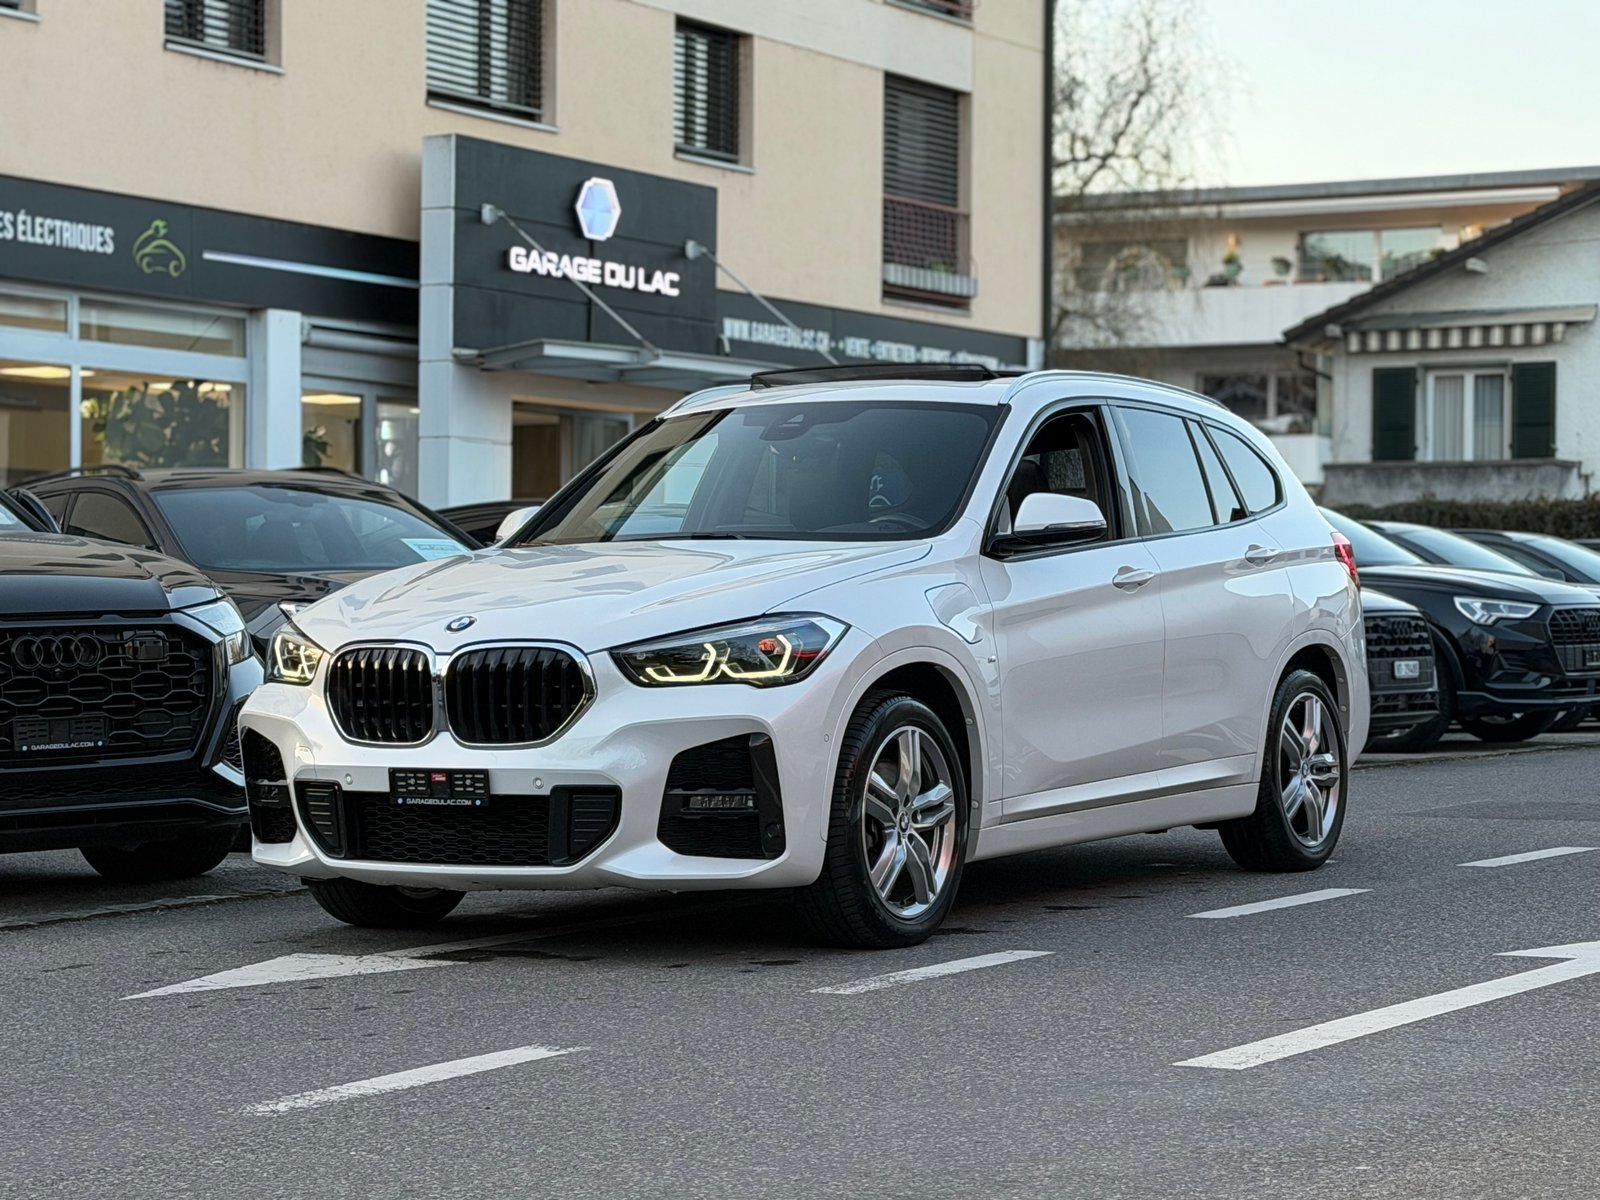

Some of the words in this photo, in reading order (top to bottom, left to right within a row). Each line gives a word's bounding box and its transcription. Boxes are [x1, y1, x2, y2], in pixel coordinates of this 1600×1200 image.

[16, 209, 115, 254] ÉLECTRIQUES
[509, 246, 602, 284] GARAGE
[604, 261, 635, 289] DU
[637, 267, 680, 296] LAC
[31, 741, 94, 751] GARAGEDULAC.COM
[406, 798, 472, 806] GARAGEDULAC.COM
